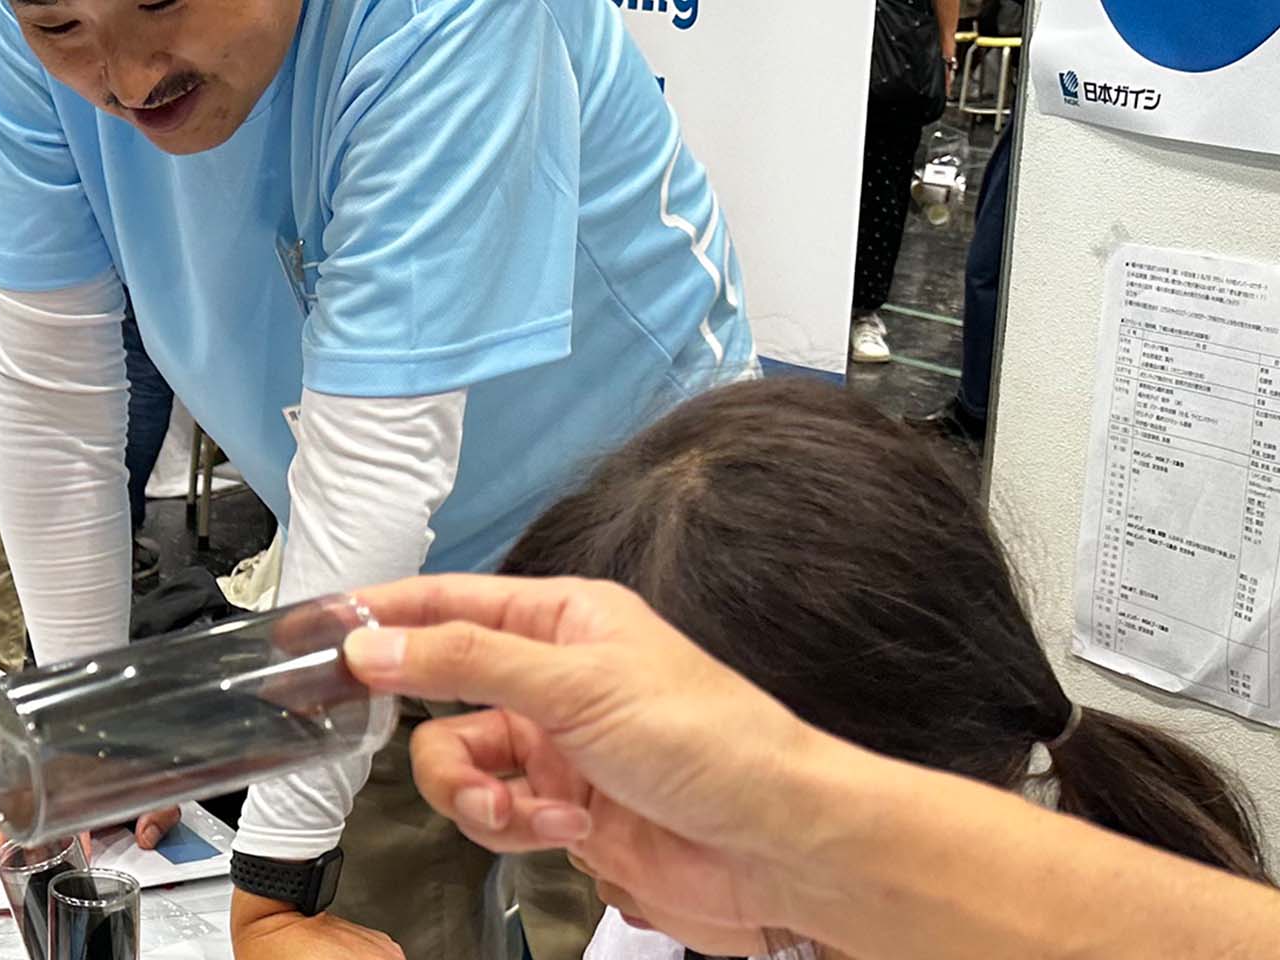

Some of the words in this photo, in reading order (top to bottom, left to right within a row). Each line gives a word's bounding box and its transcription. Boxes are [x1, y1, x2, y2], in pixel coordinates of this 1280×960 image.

[1083, 82, 1162, 110] 日本ガイシ
